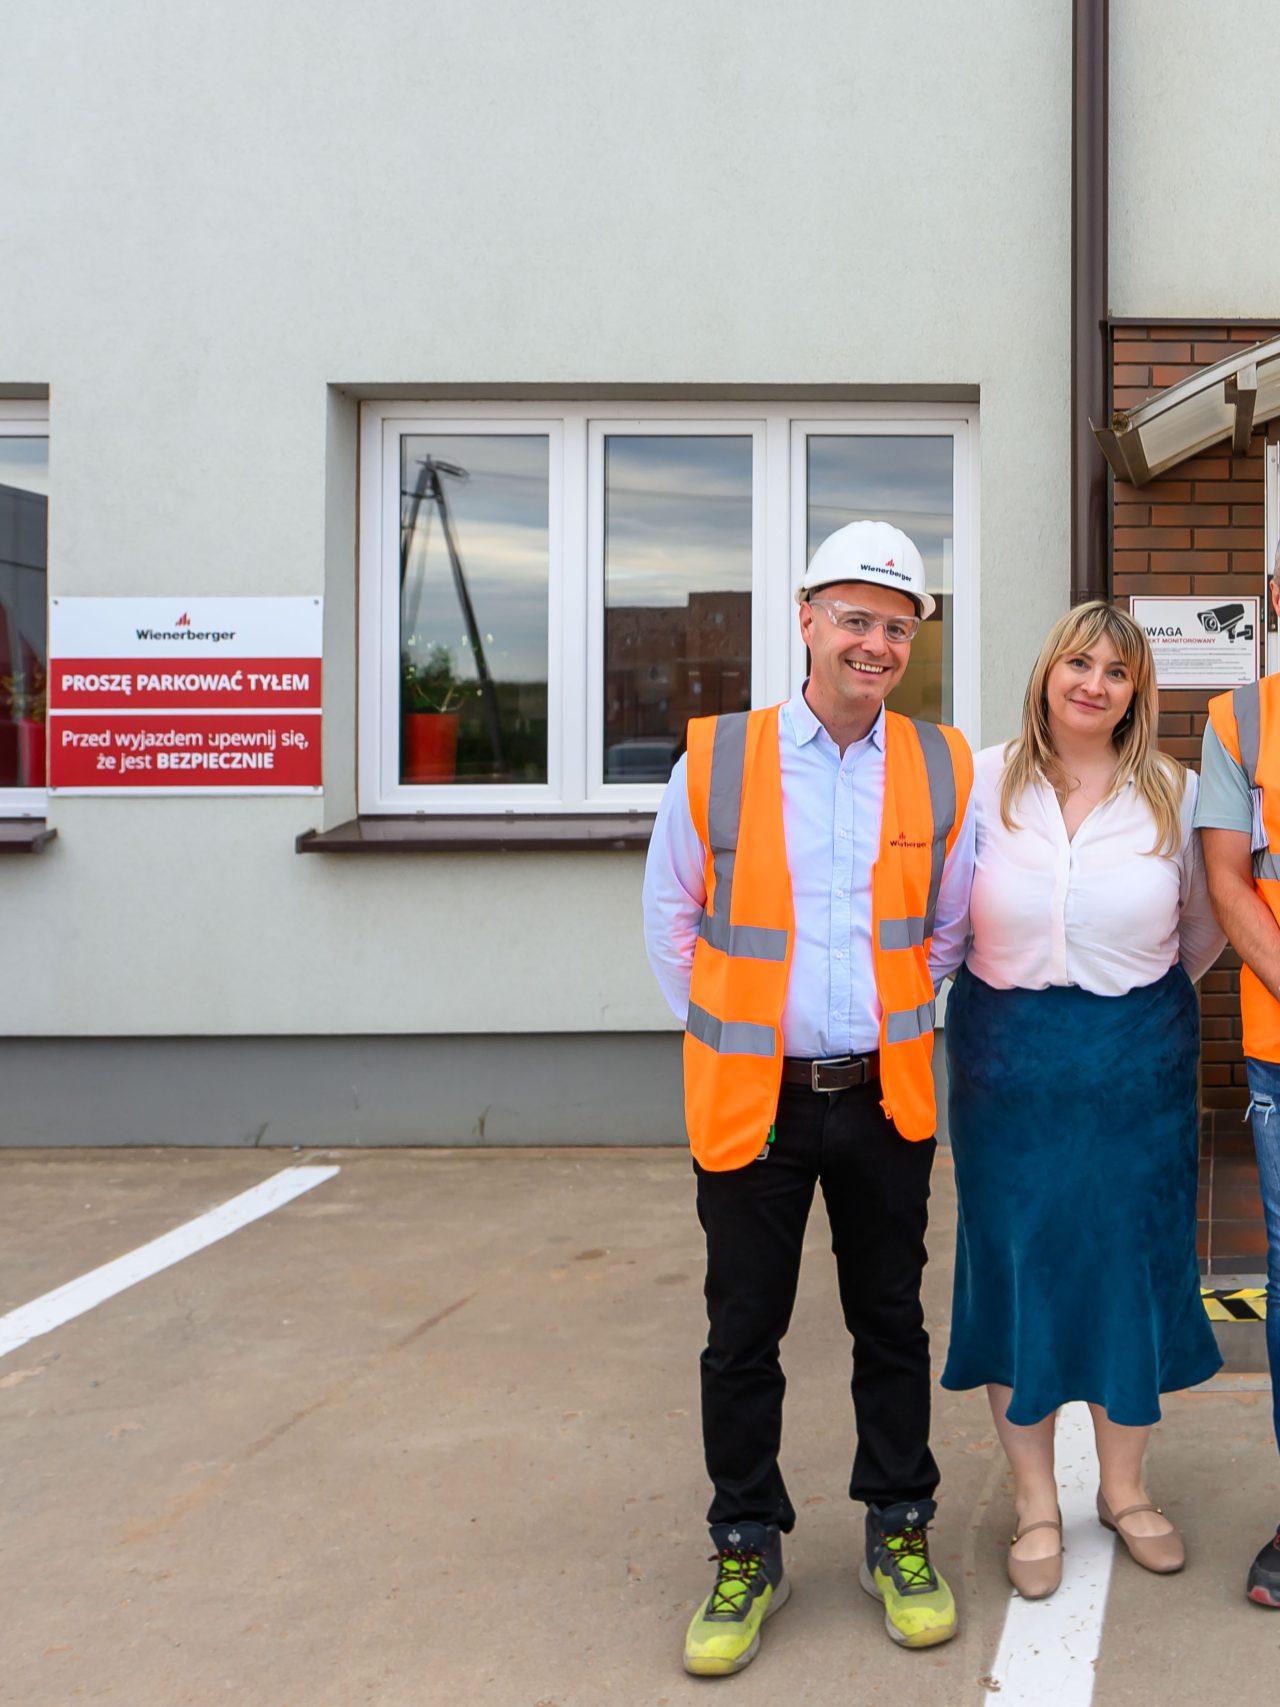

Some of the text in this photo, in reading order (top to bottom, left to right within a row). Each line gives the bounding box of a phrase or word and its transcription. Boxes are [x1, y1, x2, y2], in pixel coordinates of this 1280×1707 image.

[861, 564, 912, 582] Wienerberger
[136, 629, 236, 642] Wienerberger
[1143, 627, 1182, 637] WAGA
[62, 670, 309, 695] PROSZĘ PARKOWAĆ TYŁEM
[62, 730, 309, 751] Przed wyjazdem upewnij się,
[96, 752, 274, 773] że jest BEZPIECZNIE
[890, 840, 926, 848] Wiberger
